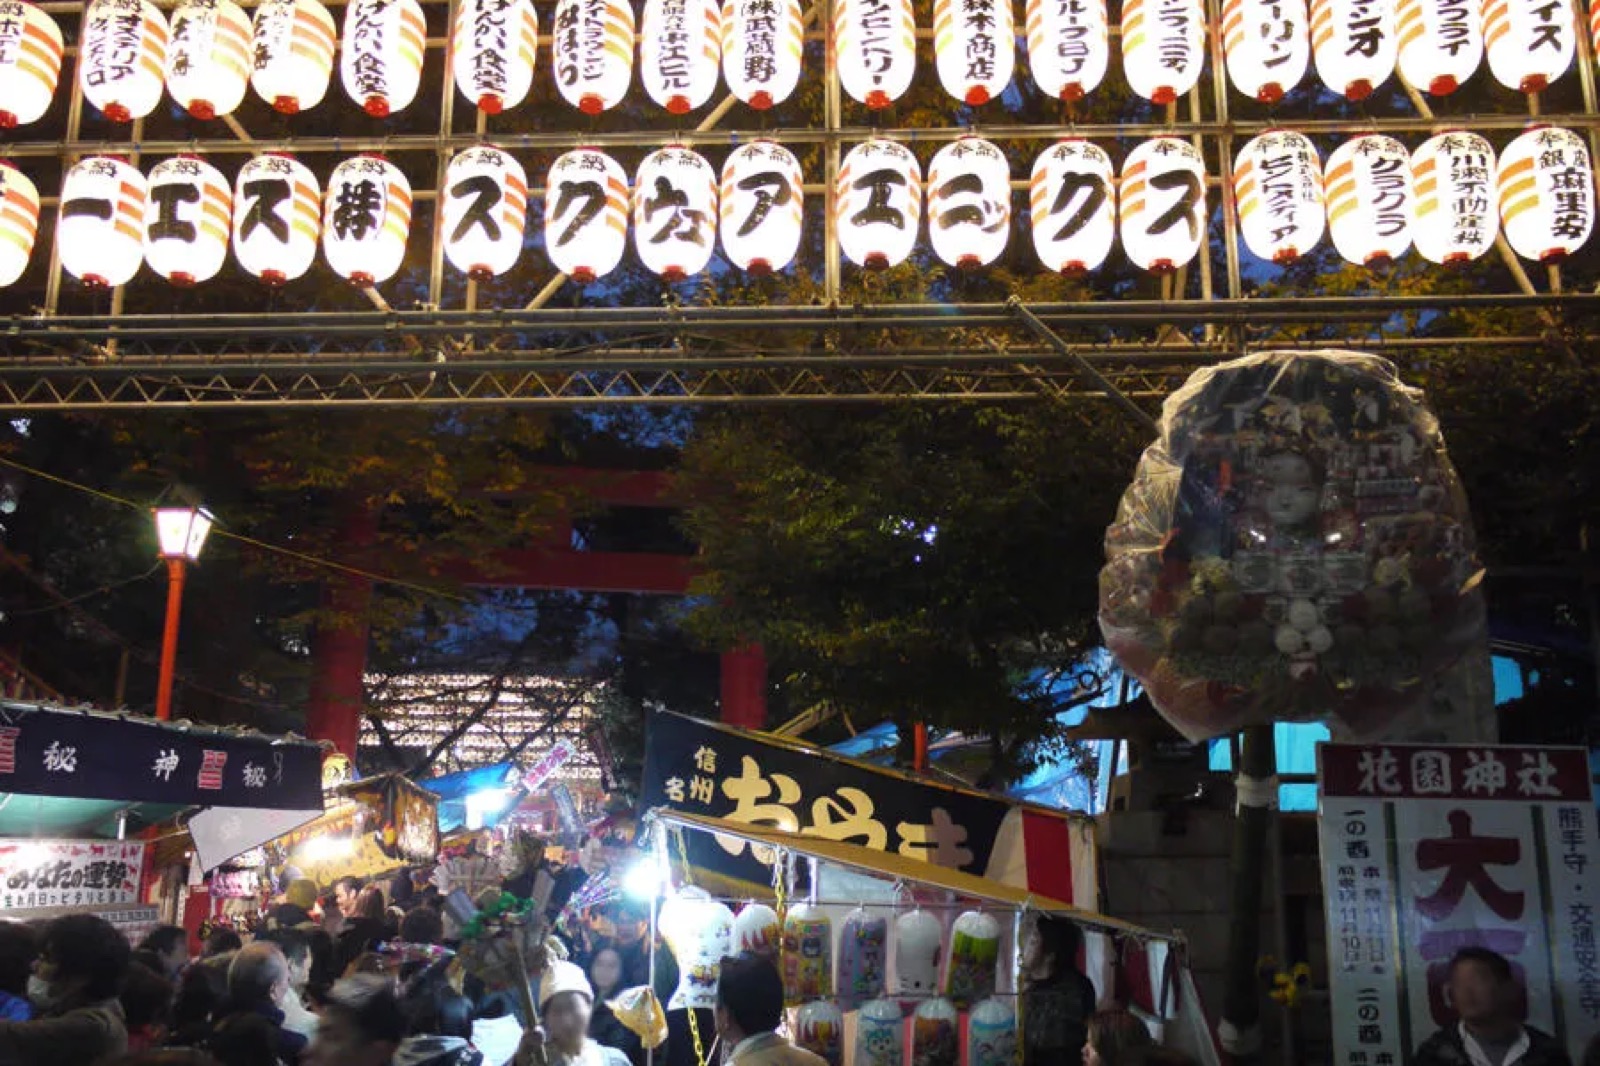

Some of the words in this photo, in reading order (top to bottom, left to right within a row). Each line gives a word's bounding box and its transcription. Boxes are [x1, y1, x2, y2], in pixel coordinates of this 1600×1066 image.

[1370, 155, 1407, 237] クラクラ
[152, 750, 180, 782] 神
[693, 745, 717, 804] 信州
[1357, 749, 1563, 796] 花園神社
